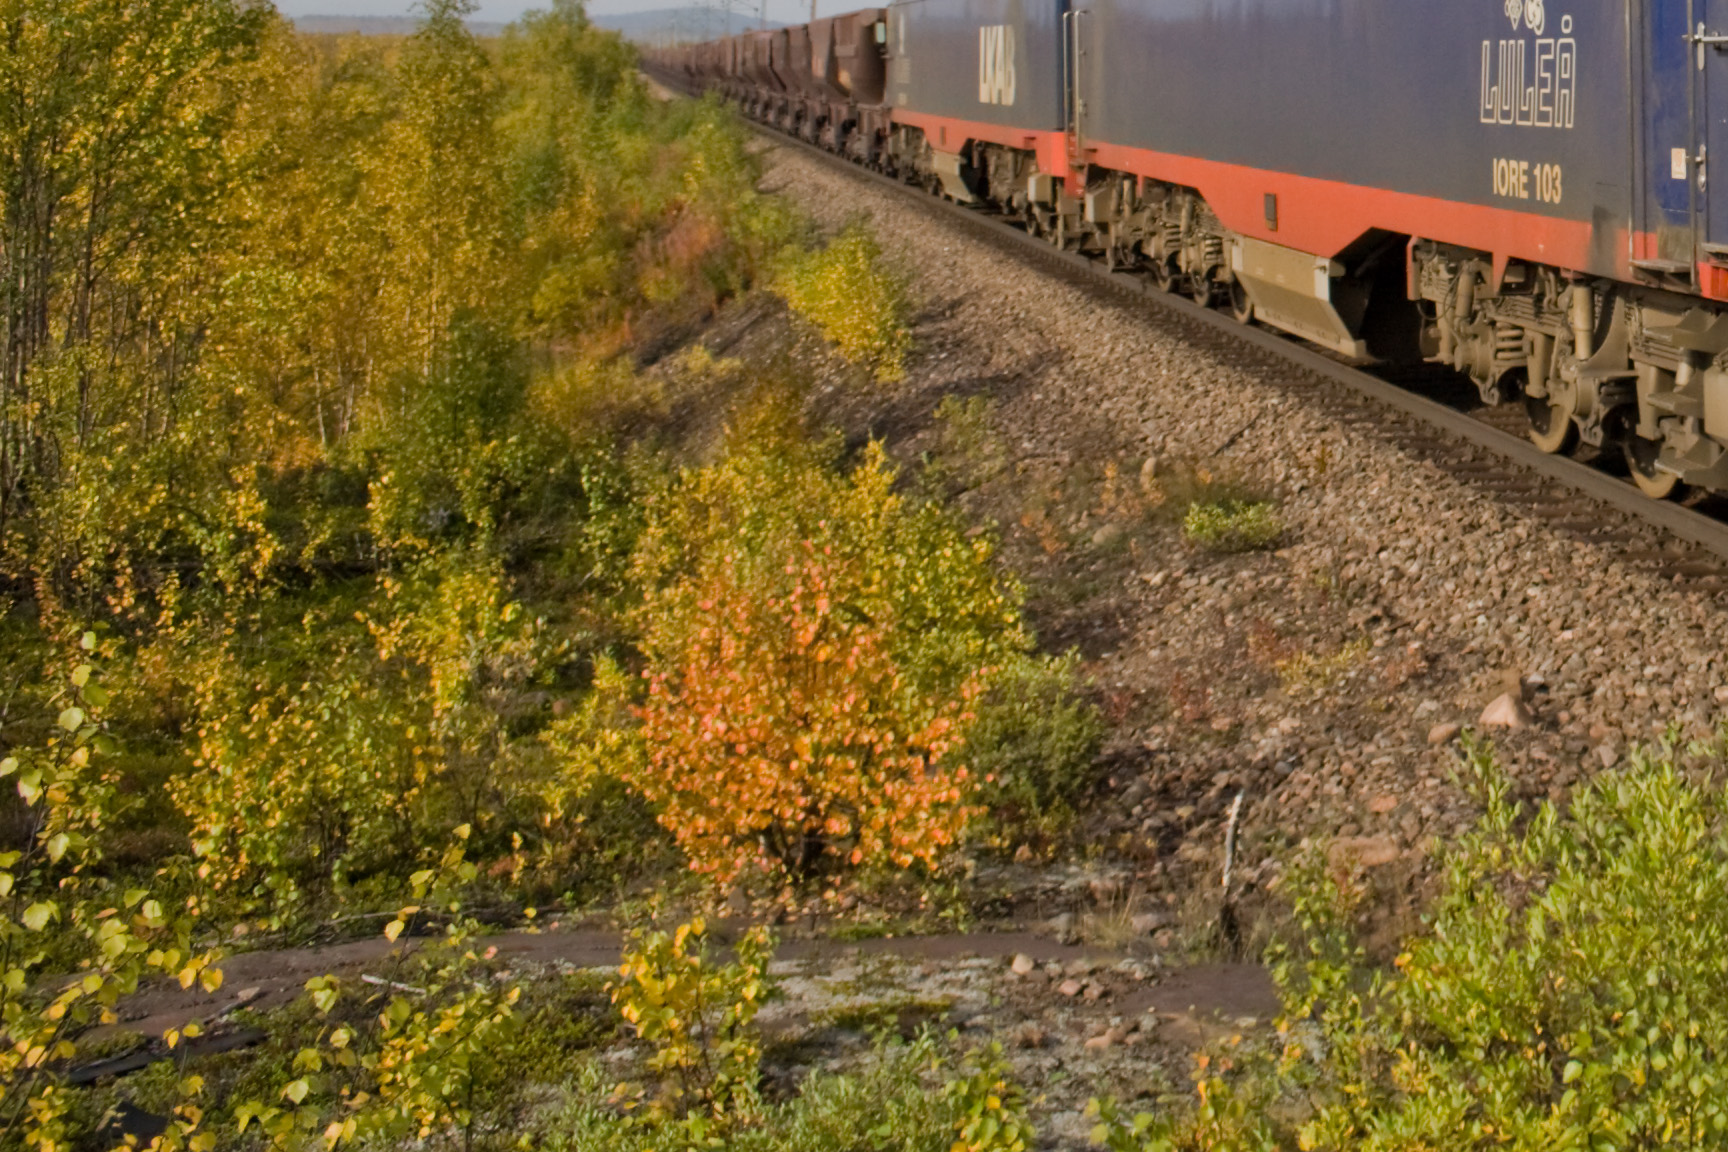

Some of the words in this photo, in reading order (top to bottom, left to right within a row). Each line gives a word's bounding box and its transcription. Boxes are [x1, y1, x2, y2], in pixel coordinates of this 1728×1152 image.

[978, 24, 1016, 106] LKAB
[1480, 13, 1577, 128] LULEÅ
[1493, 158, 1529, 199] IORE
[1533, 163, 1562, 204] 103
